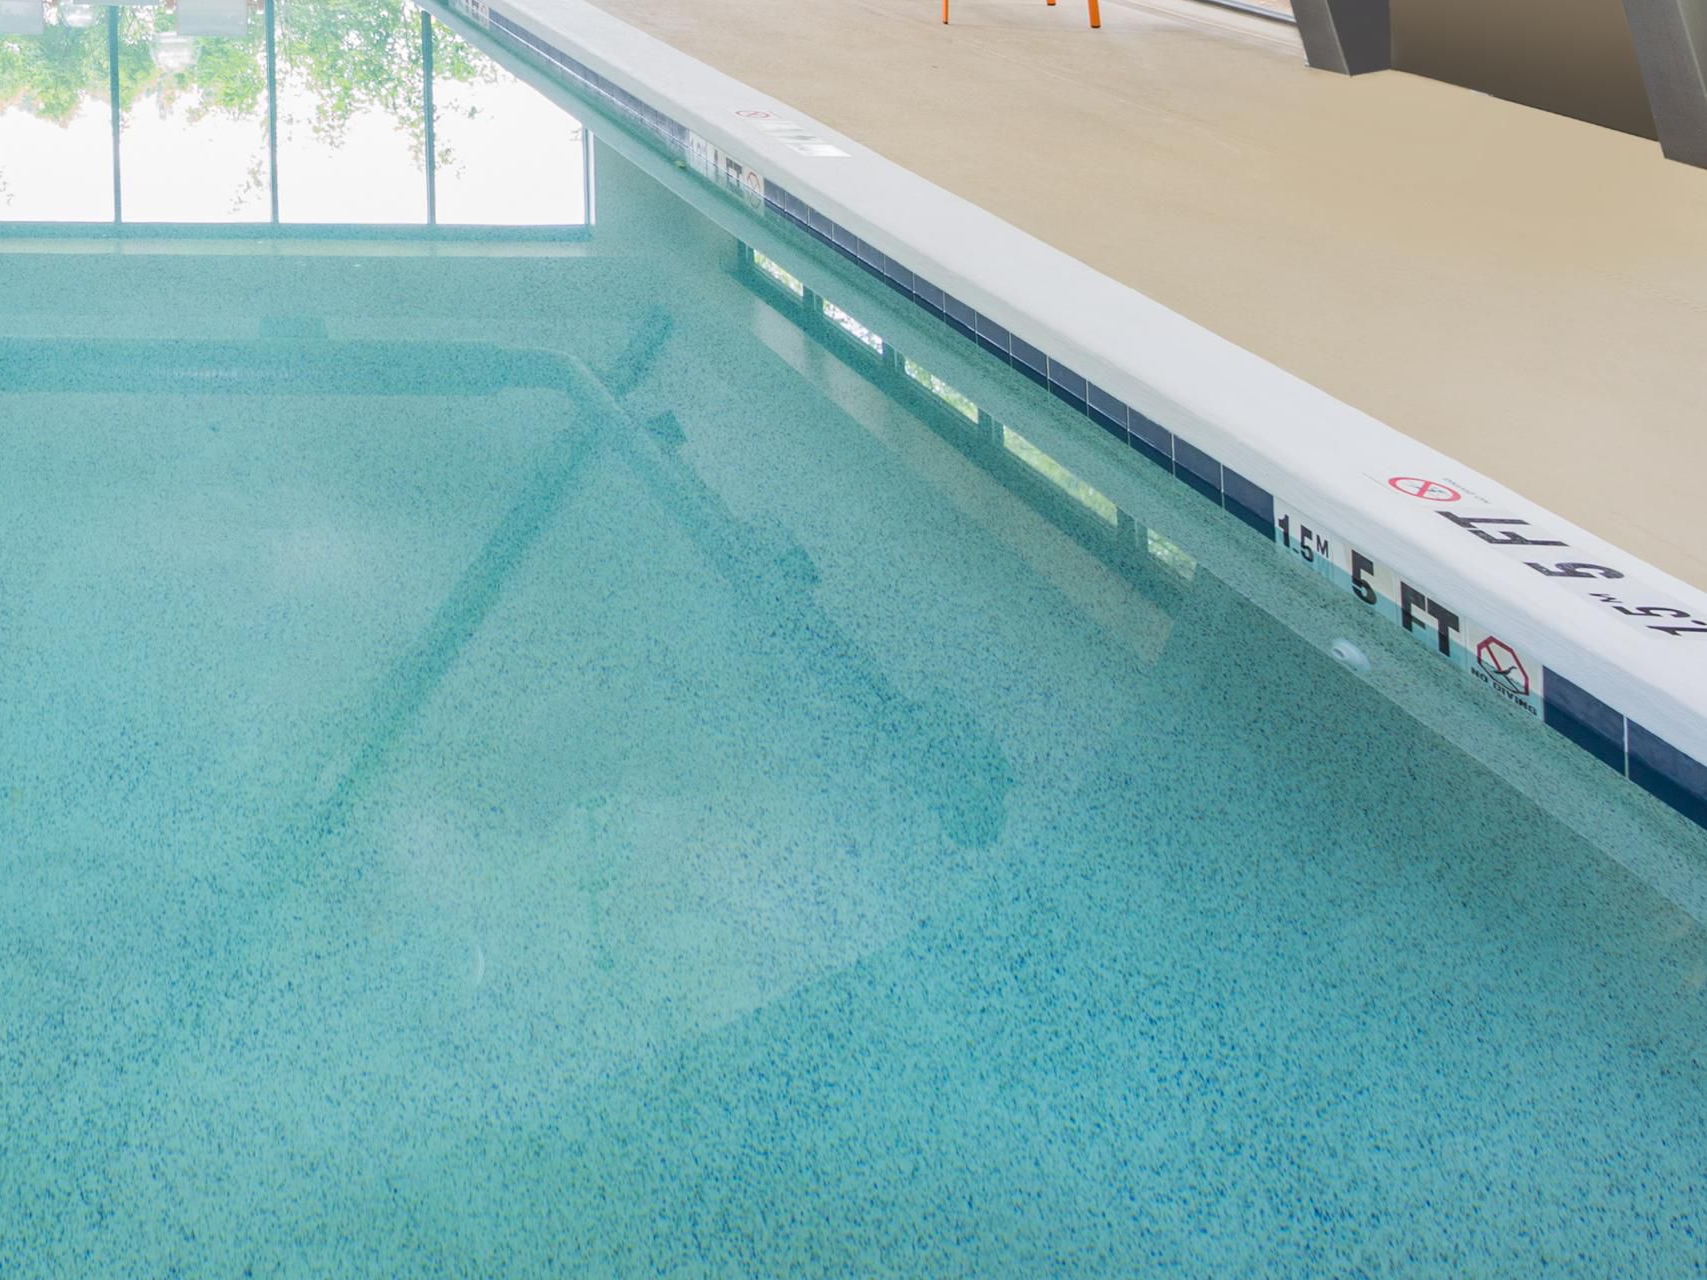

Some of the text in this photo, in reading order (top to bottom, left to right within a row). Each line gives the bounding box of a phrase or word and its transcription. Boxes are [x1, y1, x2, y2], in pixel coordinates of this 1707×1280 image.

[1434, 510, 1570, 548] FT
[1523, 561, 1625, 580] 5
[1352, 549, 1377, 605] 5
[1400, 580, 1460, 658] FT
[1470, 666, 1538, 716] NO DIVING
